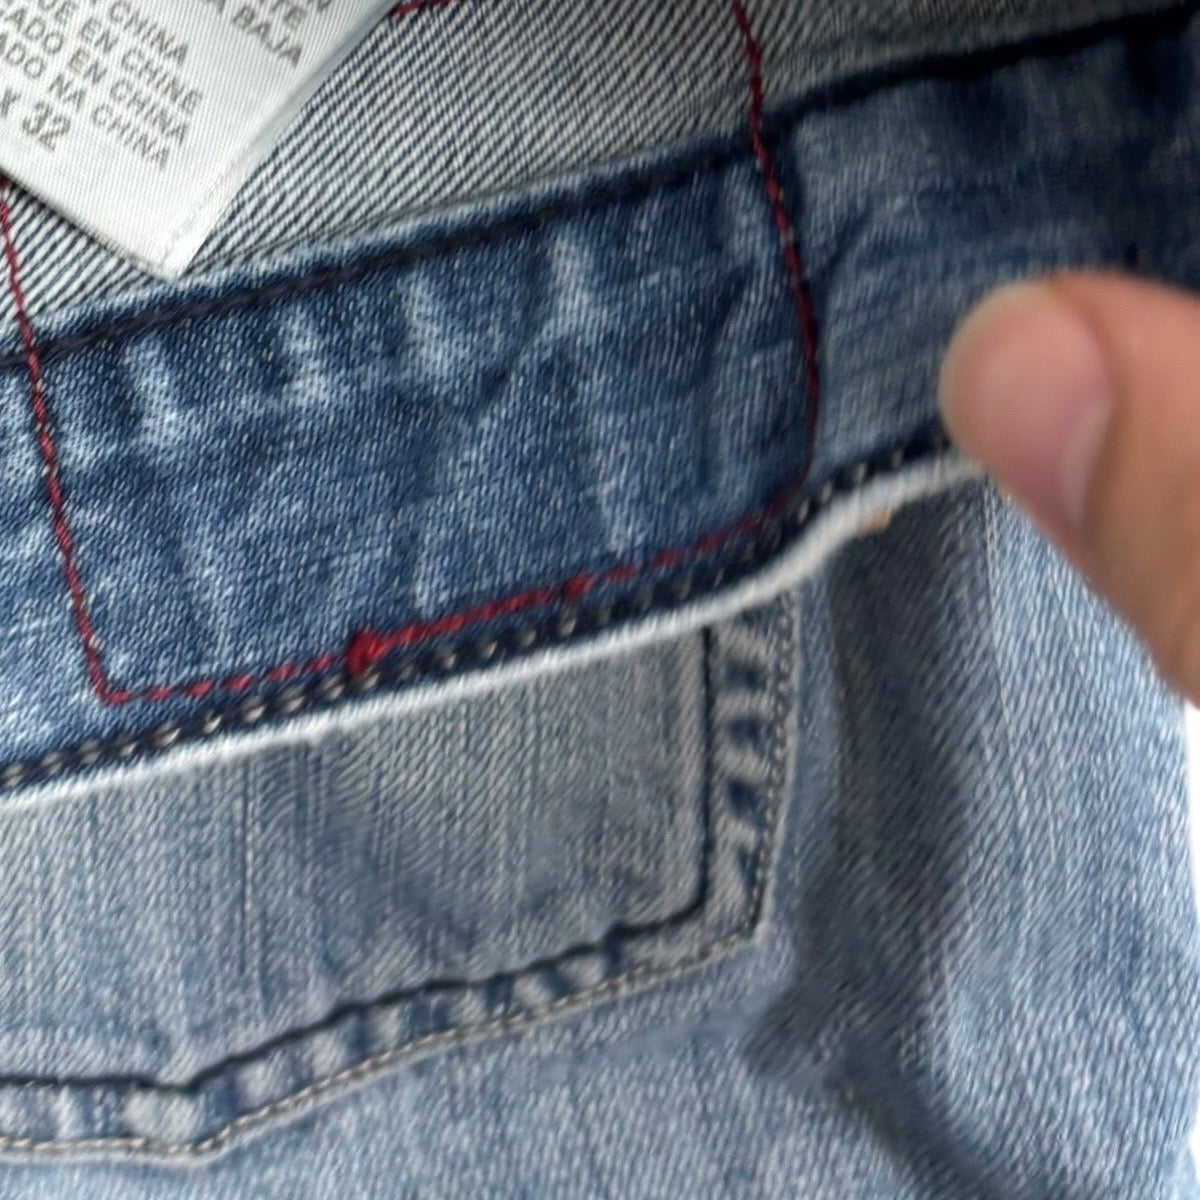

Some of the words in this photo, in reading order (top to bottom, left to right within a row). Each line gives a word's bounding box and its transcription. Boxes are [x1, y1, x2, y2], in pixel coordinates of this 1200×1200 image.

[77, 18, 118, 54] EN
[120, 47, 203, 116] CHINE
[108, 0, 190, 68] CHINA
[232, 6, 303, 68] BAJA
[20, 101, 72, 152] 32
[48, 75, 87, 111] NA
[90, 104, 171, 170] CHINA
[65, 50, 106, 86] EN
[109, 78, 190, 146] CHINA
